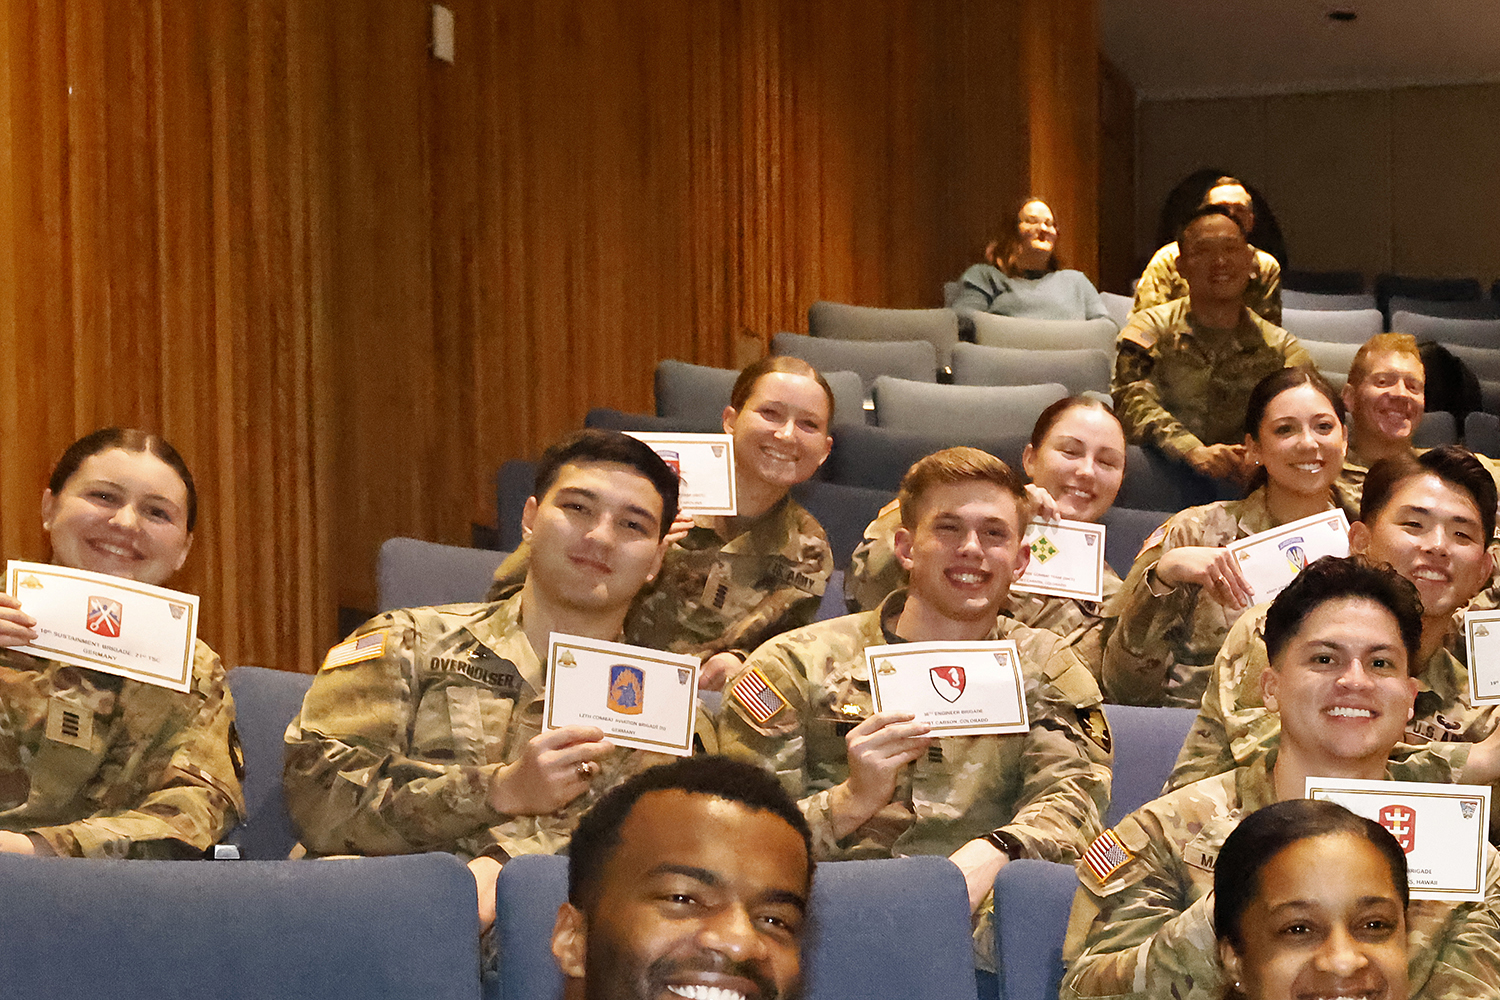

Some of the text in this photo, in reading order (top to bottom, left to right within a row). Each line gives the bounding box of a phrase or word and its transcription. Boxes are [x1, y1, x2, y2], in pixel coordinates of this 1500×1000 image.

[54, 631, 100, 647] SUSTAINMENT
[83, 647, 117, 660] GERMANY
[430, 657, 514, 688] OVERHOLSER
[593, 714, 613, 722] COMBAT
[934, 709, 960, 717] ENGINEER
[611, 727, 635, 735] GERMANY
